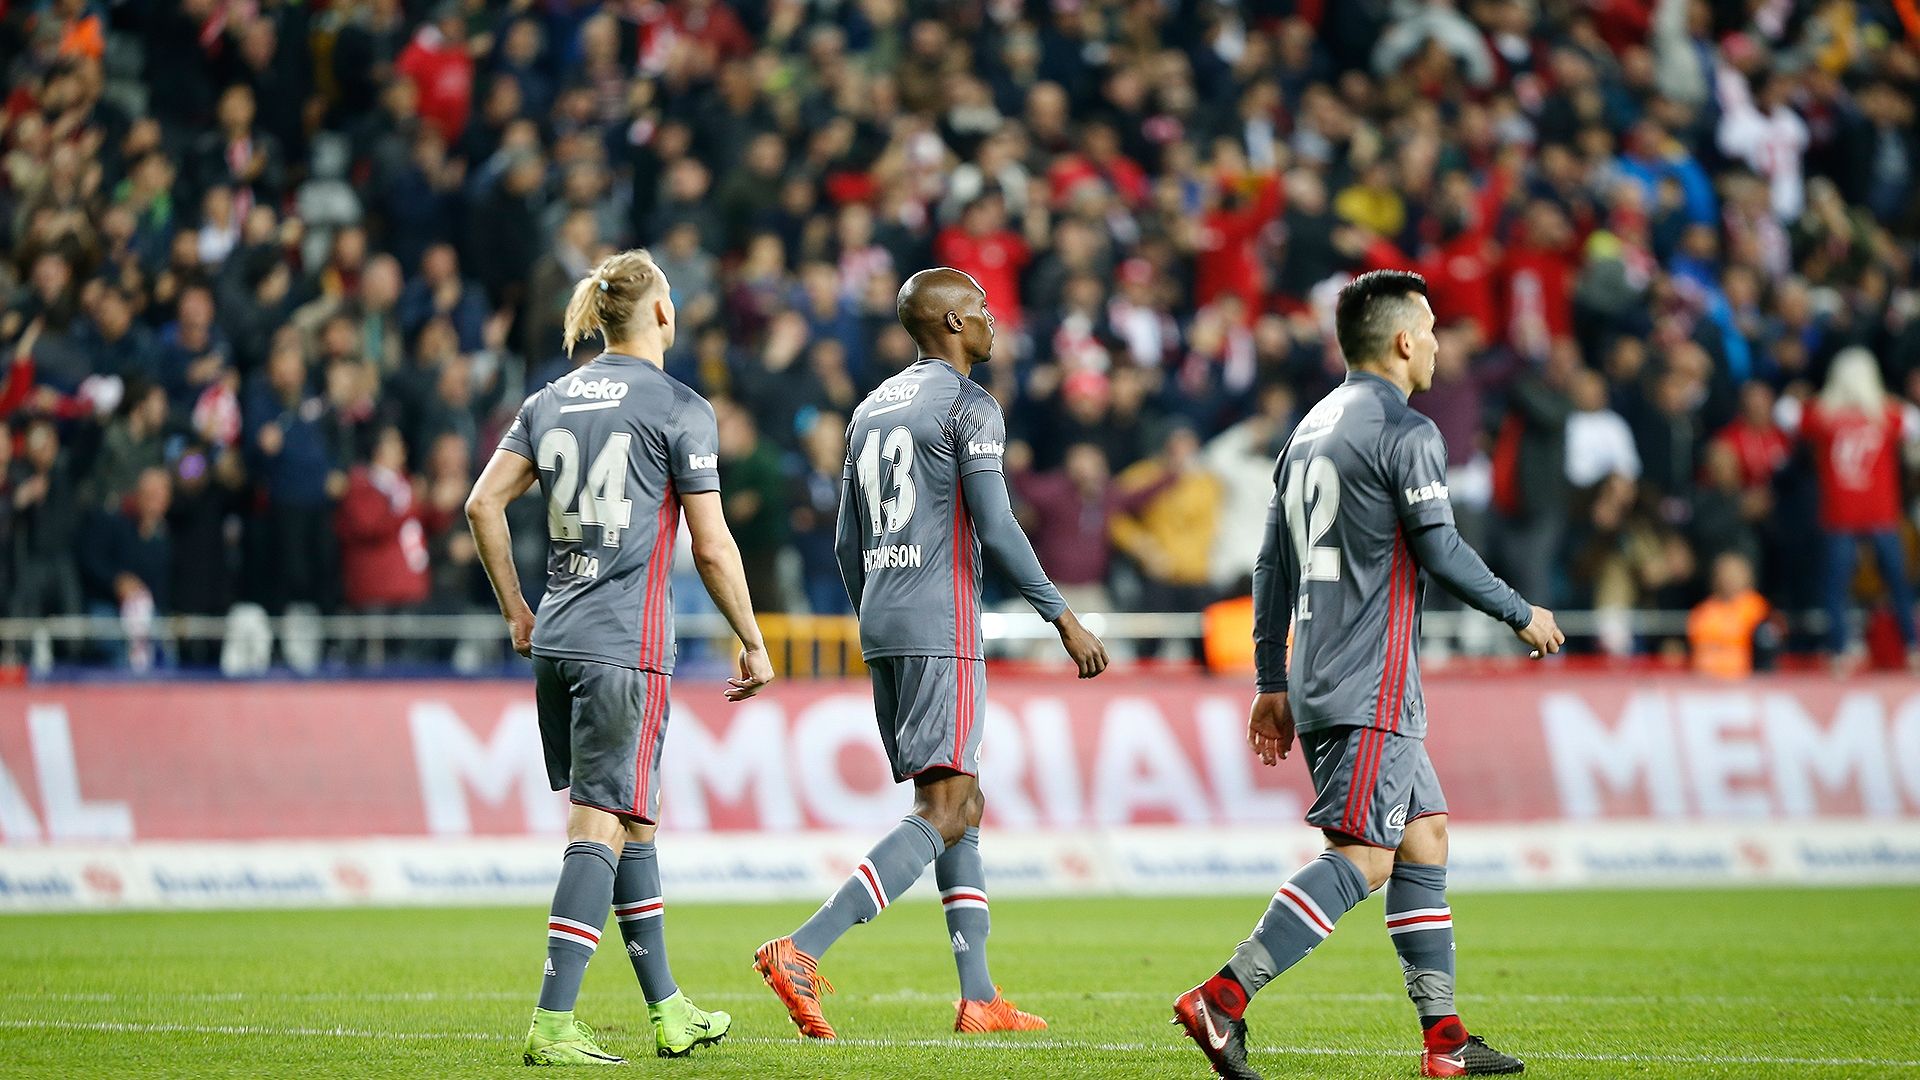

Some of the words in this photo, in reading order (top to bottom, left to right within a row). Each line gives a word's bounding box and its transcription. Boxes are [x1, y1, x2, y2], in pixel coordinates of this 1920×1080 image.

[566, 378, 629, 401] beko
[873, 383, 920, 407] beko
[537, 428, 634, 548] 24
[856, 426, 917, 537] 13
[1281, 456, 1341, 582] 12
[406, 697, 1298, 833] MMORIAL
